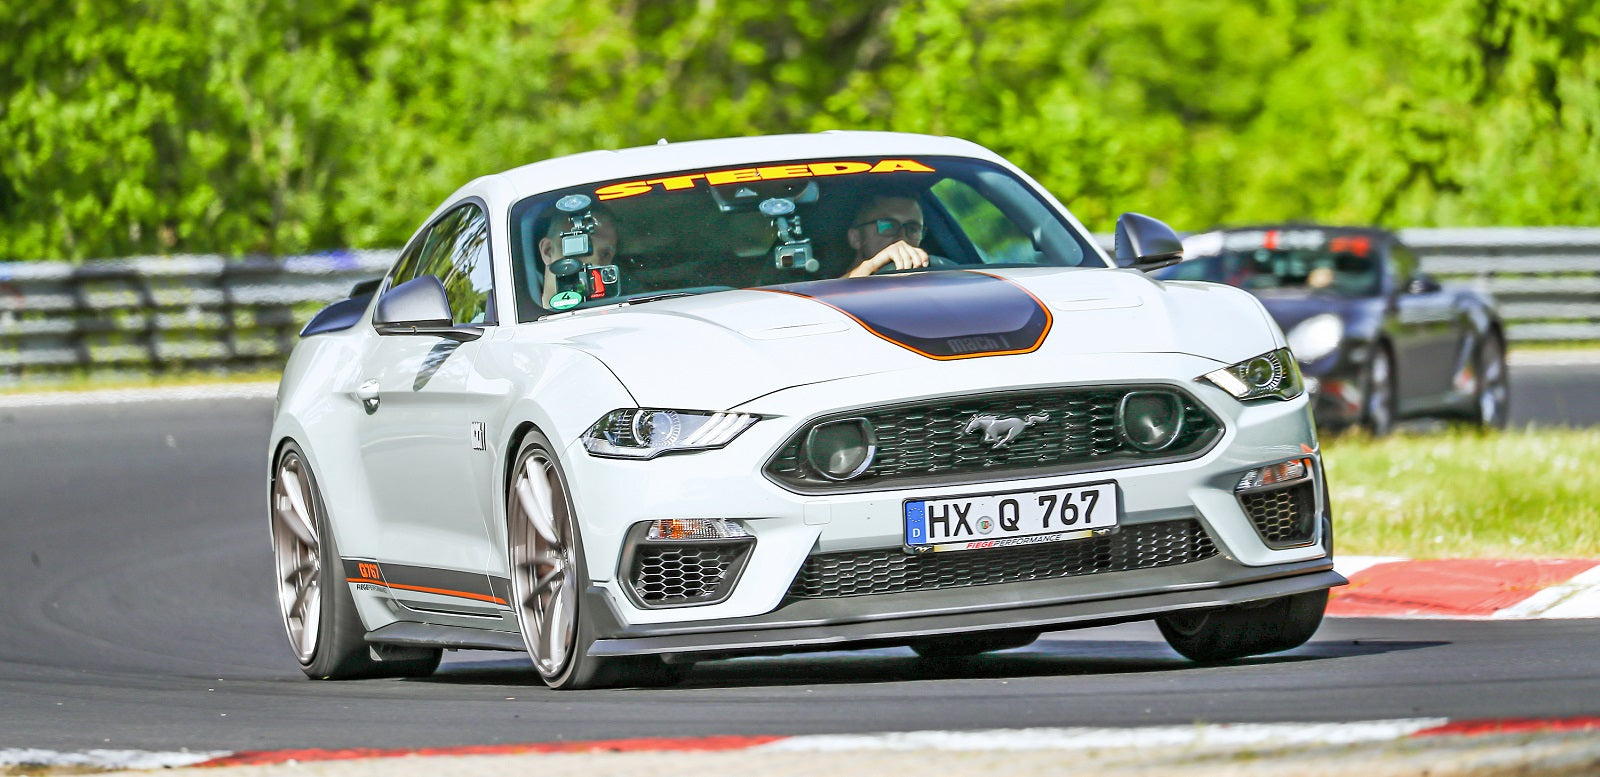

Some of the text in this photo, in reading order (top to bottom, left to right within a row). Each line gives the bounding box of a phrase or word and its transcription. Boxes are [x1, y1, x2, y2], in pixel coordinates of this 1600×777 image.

[594, 159, 936, 201] STEEDA
[561, 292, 570, 300] 4
[928, 489, 1100, 538] HX Q 767
[912, 527, 921, 538] D
